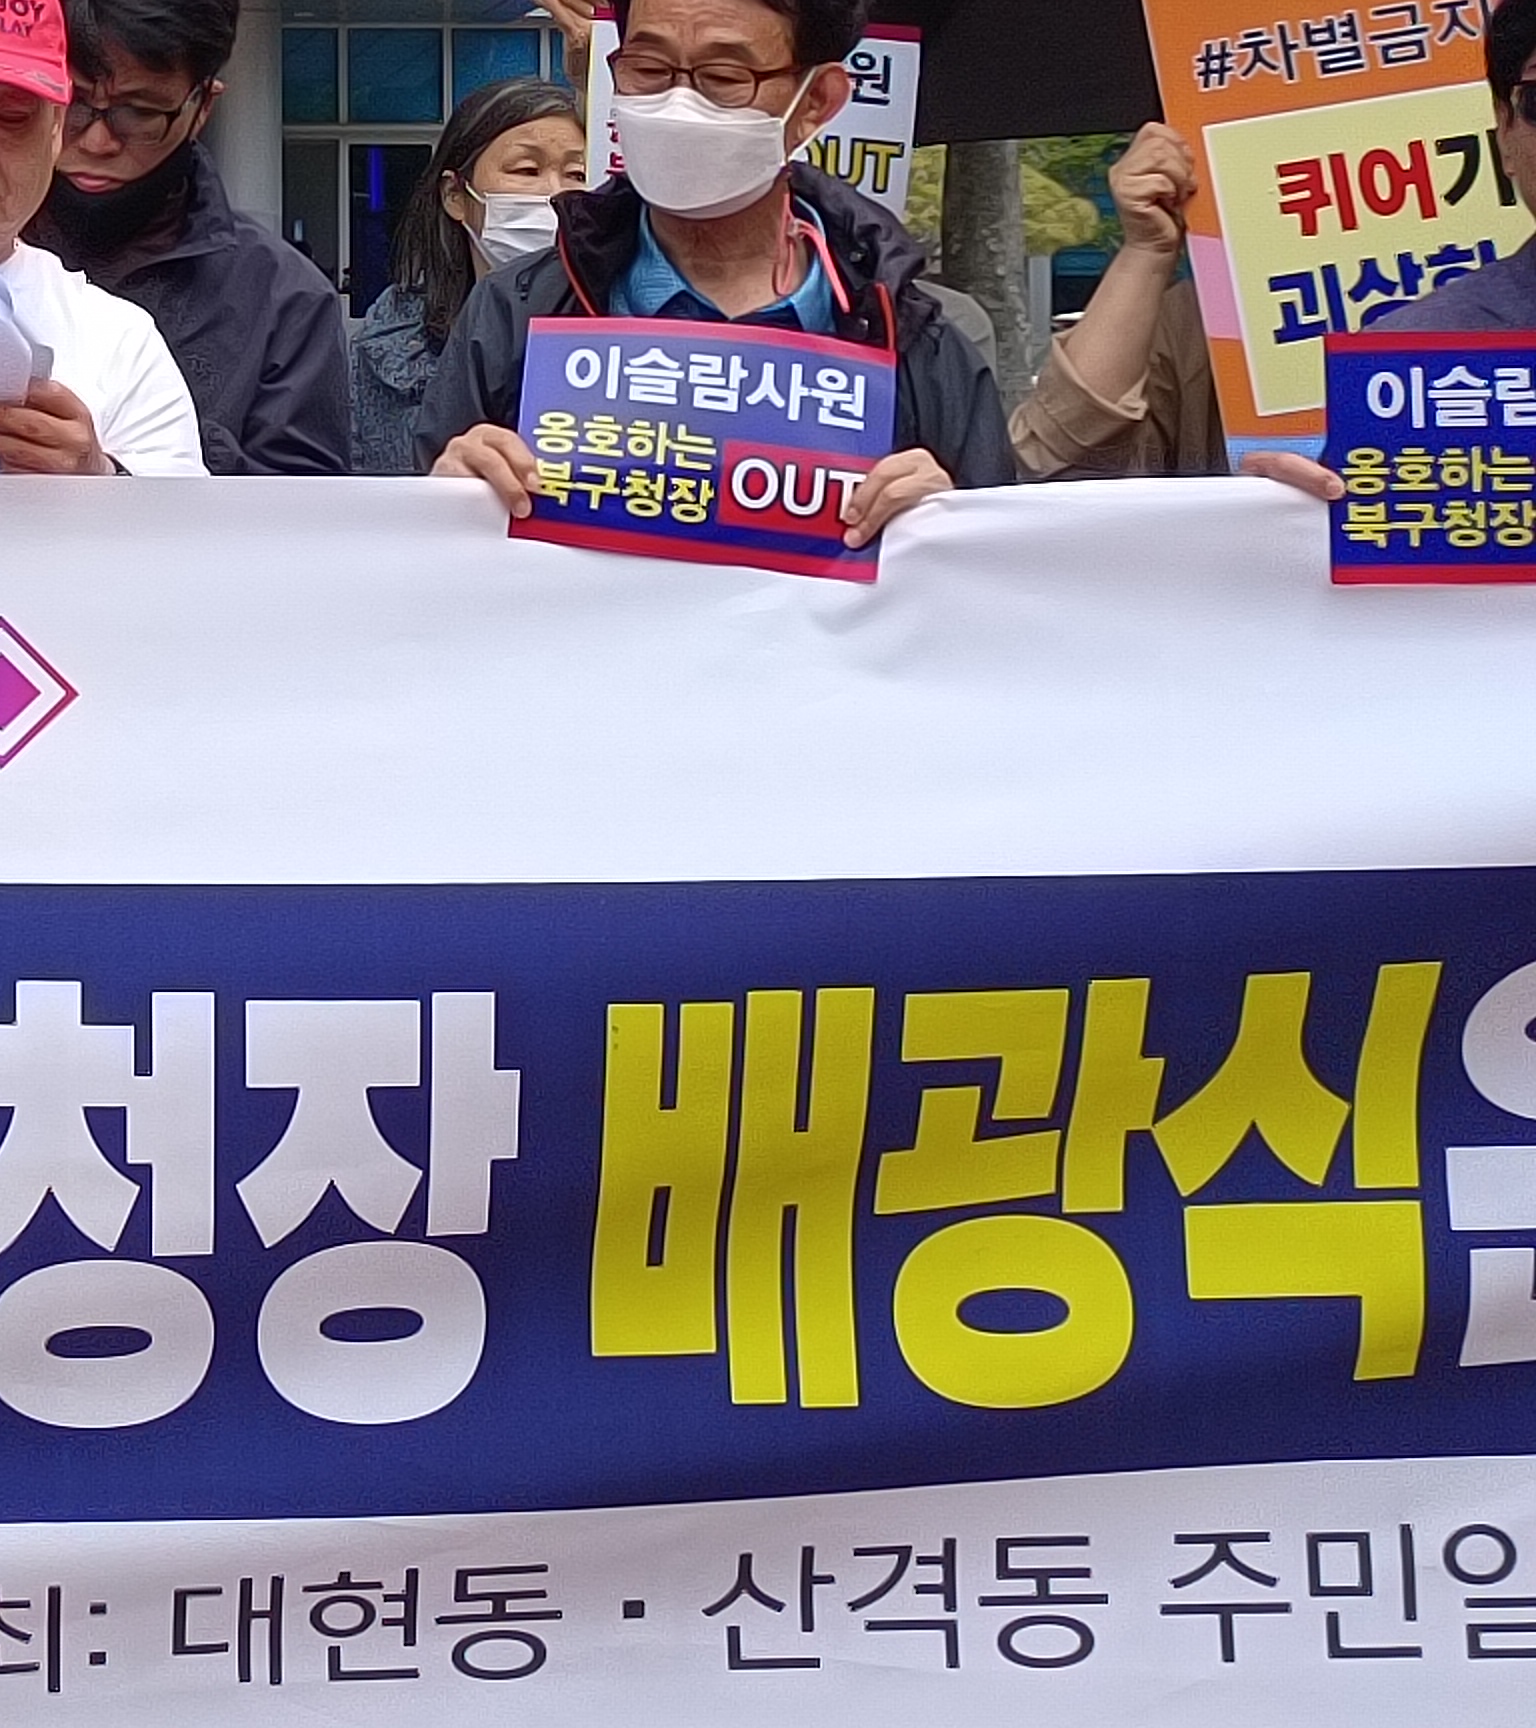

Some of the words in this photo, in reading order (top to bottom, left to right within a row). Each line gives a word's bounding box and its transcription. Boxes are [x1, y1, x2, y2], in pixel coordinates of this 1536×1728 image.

[565, 345, 866, 431] 이슬람사원
[533, 411, 717, 471] 옹호하는
[1341, 446, 1536, 494] 옹호하는
[536, 458, 716, 524] 북구청장
[731, 458, 868, 522] OUT
[1341, 500, 1536, 548] 북구청장
[169, 1561, 565, 1687] 대현동
[700, 1533, 1110, 1671] 산격동
